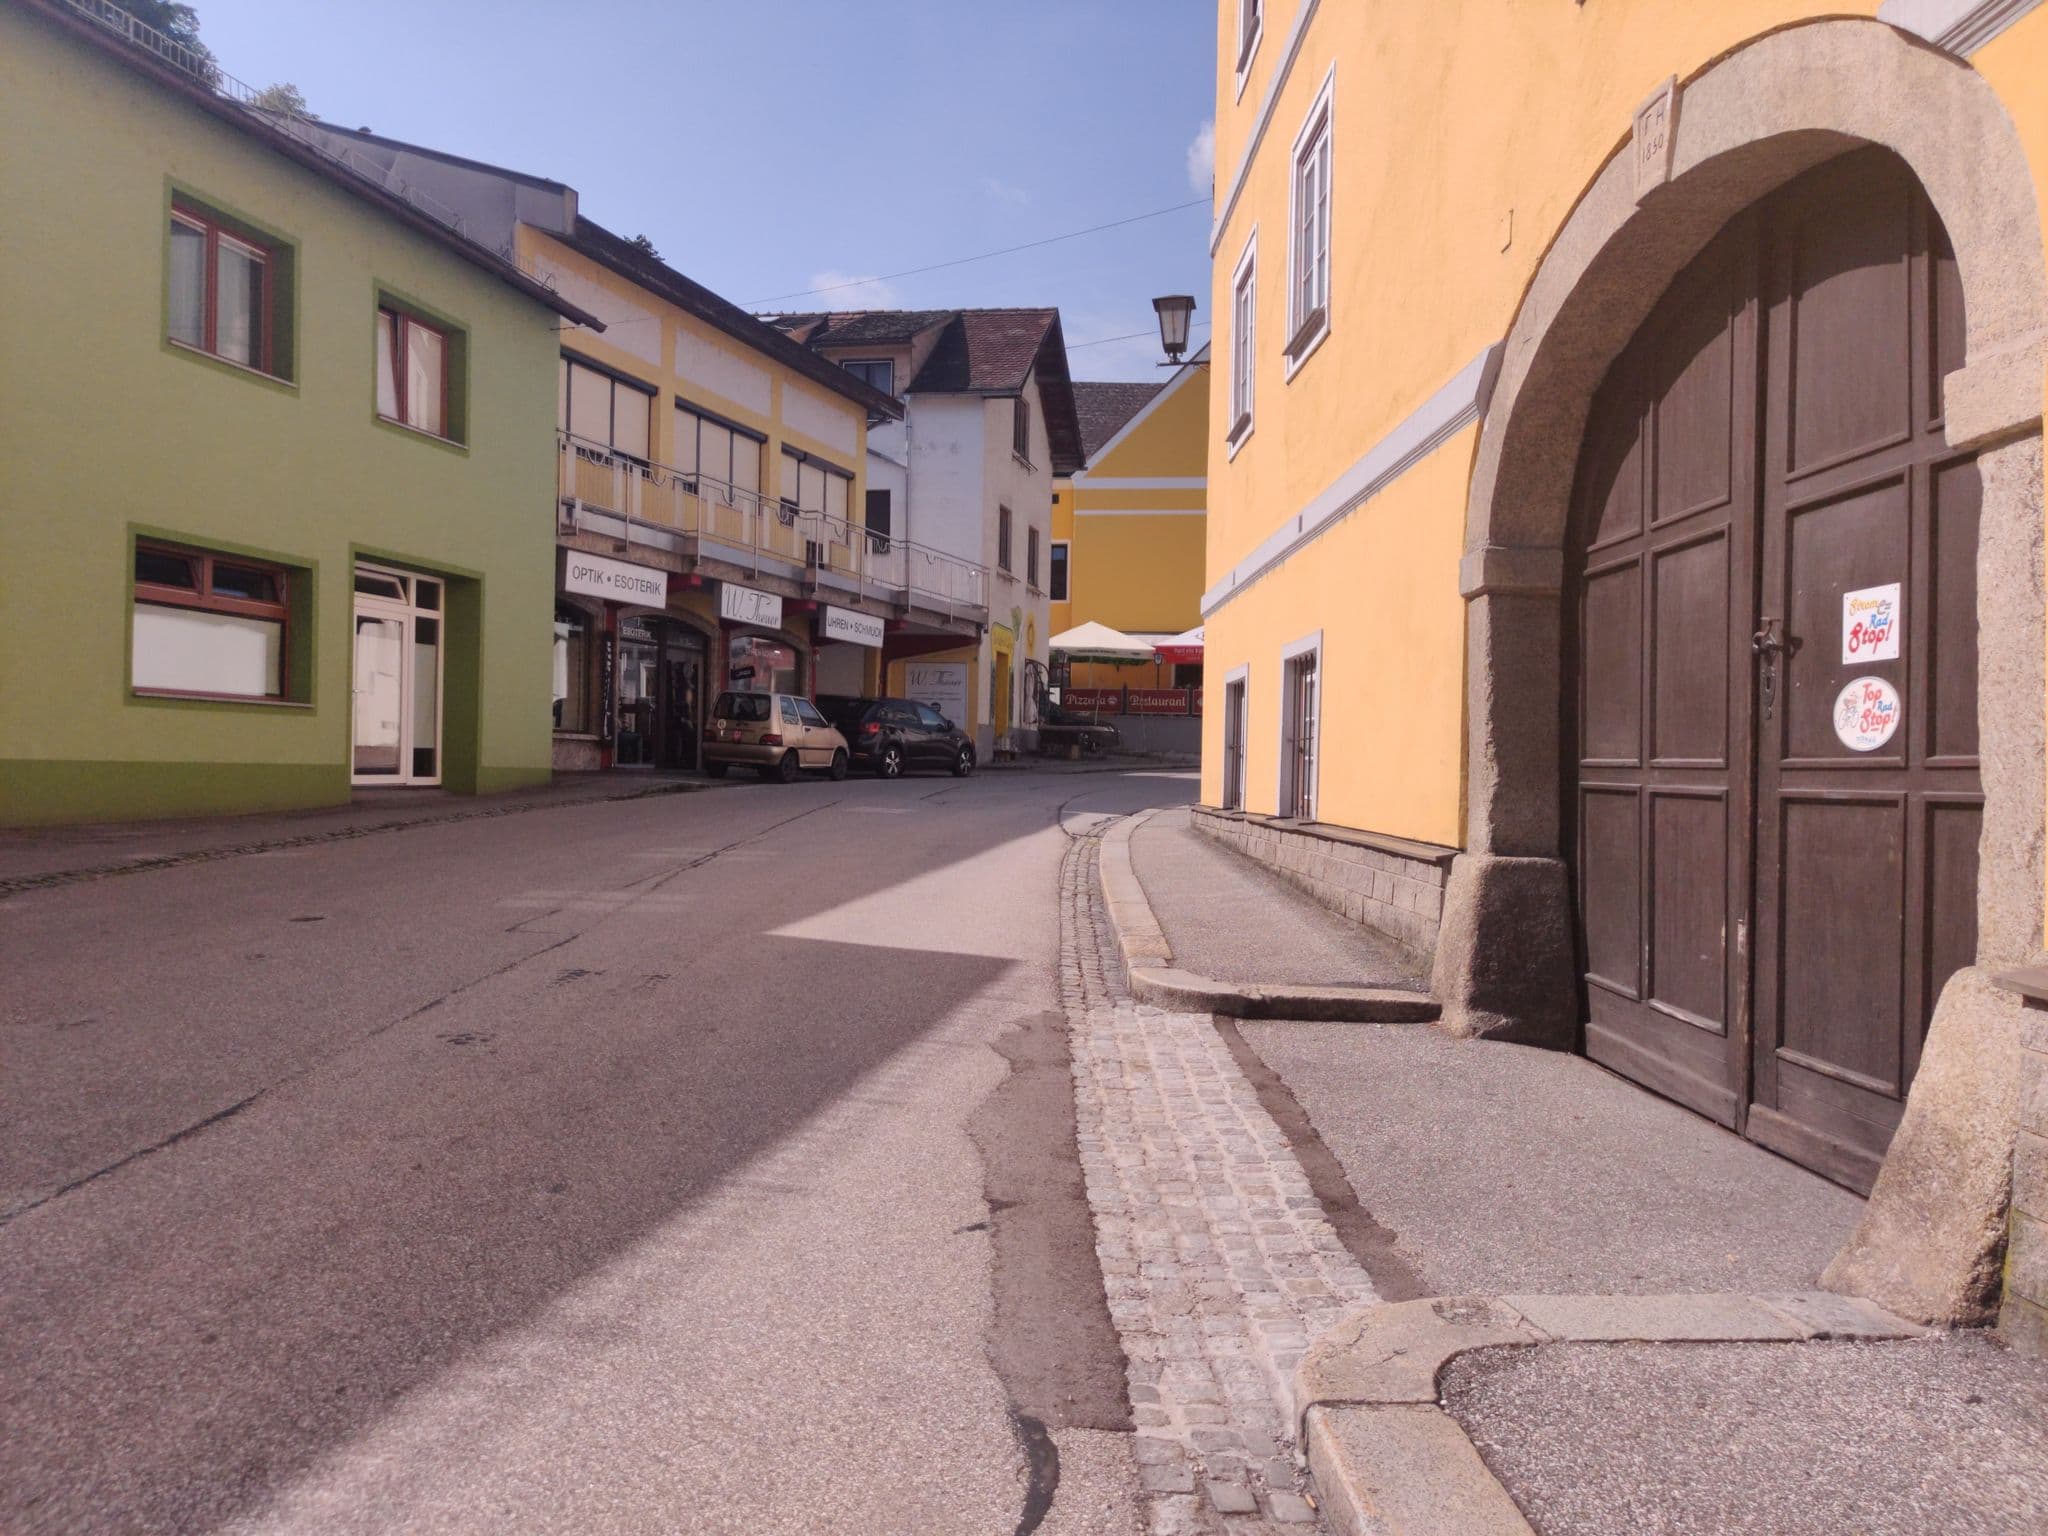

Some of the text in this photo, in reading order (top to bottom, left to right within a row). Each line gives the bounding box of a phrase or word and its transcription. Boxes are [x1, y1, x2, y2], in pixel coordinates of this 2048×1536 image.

[572, 565, 662, 596] OPTIK ESOTERIK
[827, 616, 882, 638] UHREN SCHMUCK
[1869, 612, 1889, 629] Rad
[1848, 619, 1893, 655] Stop!
[1129, 695, 1186, 708] Restaurant
[1863, 682, 1882, 709] Top
[1877, 701, 1893, 712] Rad
[1859, 704, 1896, 735] Stop!
